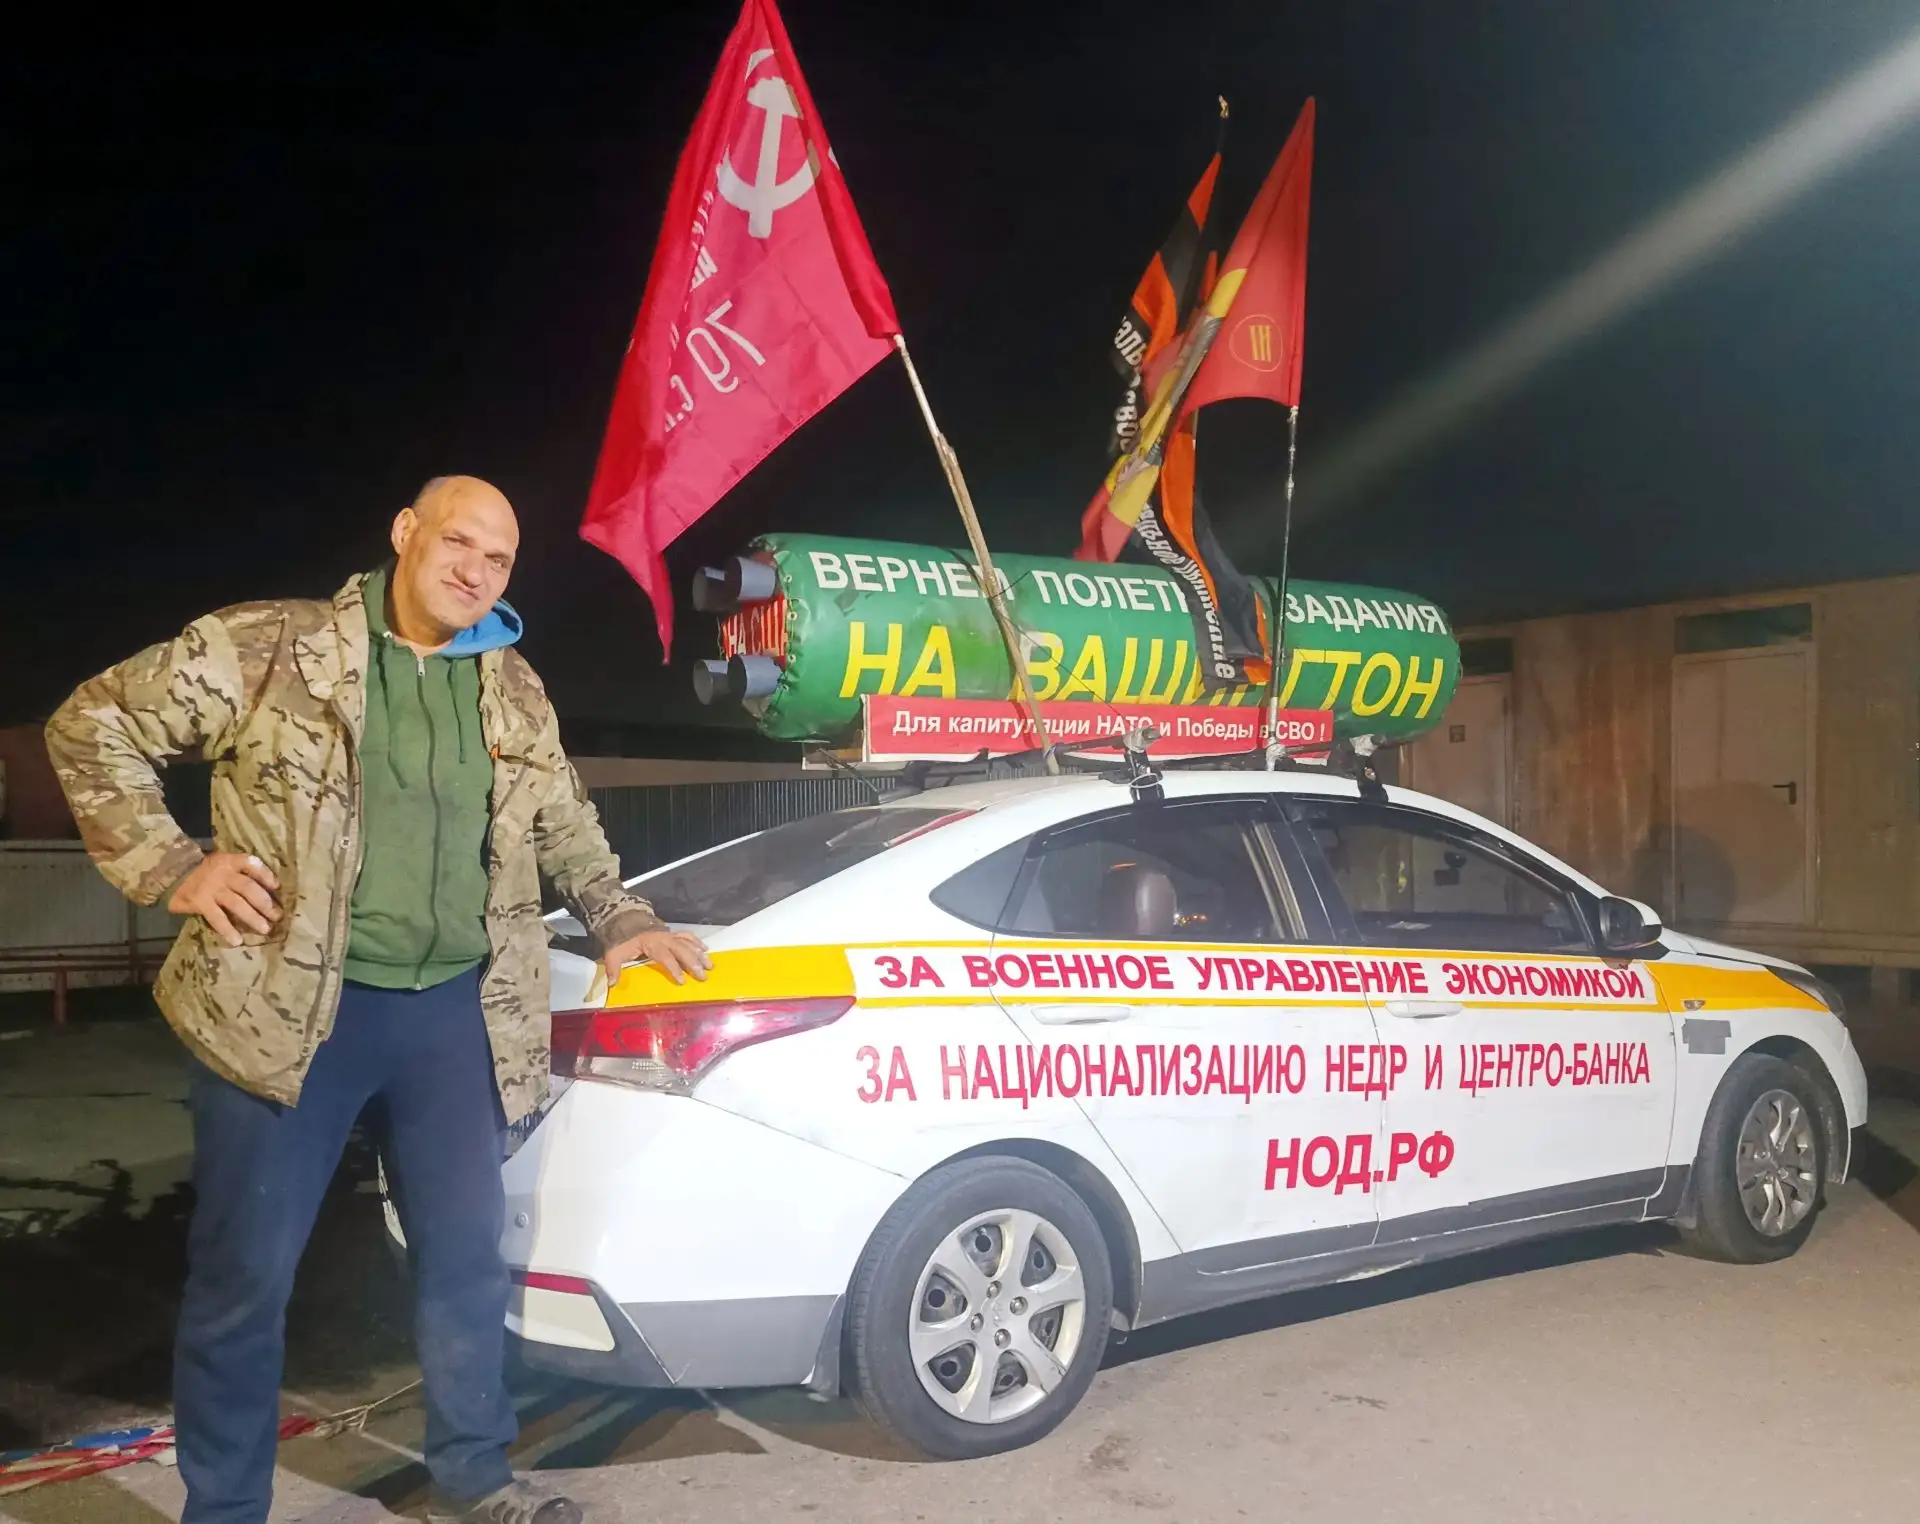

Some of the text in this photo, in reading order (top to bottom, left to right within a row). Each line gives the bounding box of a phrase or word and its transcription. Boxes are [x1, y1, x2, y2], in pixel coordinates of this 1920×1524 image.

[1286, 592, 1448, 635] ЗАДАНИЯ
[839, 621, 1444, 720] НА ВАШГТОН
[892, 710, 941, 736] Для
[1159, 721, 1171, 737] и
[1177, 717, 1254, 740] Победы
[1276, 720, 1315, 741] СВО
[874, 953, 1645, 999] ЗА ВОЕННОЕ УПРАВЛЕНИЕ ЭКОНОМИКОЙ
[856, 1042, 1651, 1110] ЗА НАЦИОНАЛИЗАЦИЮ НЕДР И ЦЕНТРО-БАНКА
[1264, 1130, 1456, 1196] НОД.РФ
